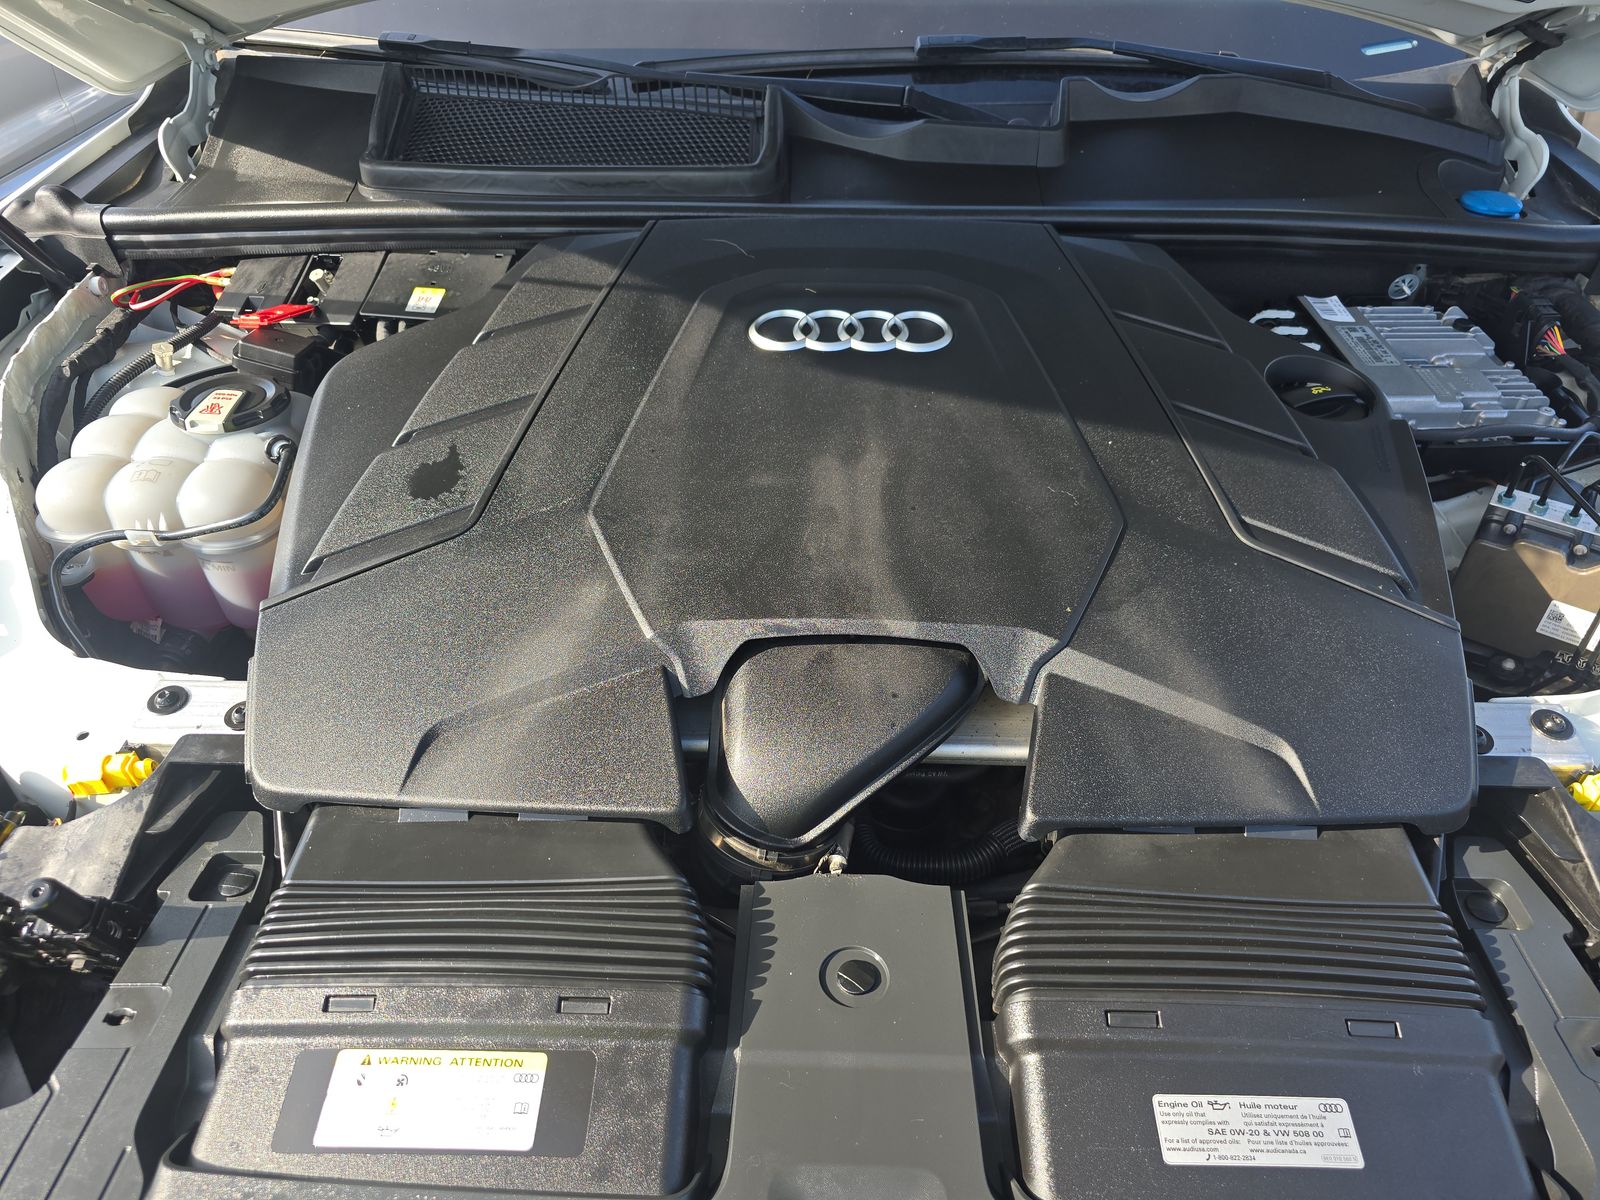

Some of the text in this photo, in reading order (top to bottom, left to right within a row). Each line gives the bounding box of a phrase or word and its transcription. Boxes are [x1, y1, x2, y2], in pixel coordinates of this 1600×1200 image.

[378, 1056, 524, 1068] WARNING ATTENTION
[1158, 1100, 1204, 1109] Engine Oil
[1239, 1101, 1262, 1110] Huile
[1264, 1112, 1299, 1120] uniquement
[1207, 1128, 1227, 1136] SAE
[1229, 1128, 1260, 1136] 0W-20
[1272, 1129, 1290, 1137] VW
[1292, 1130, 1310, 1138] 508
[1312, 1130, 1324, 1138] 00
